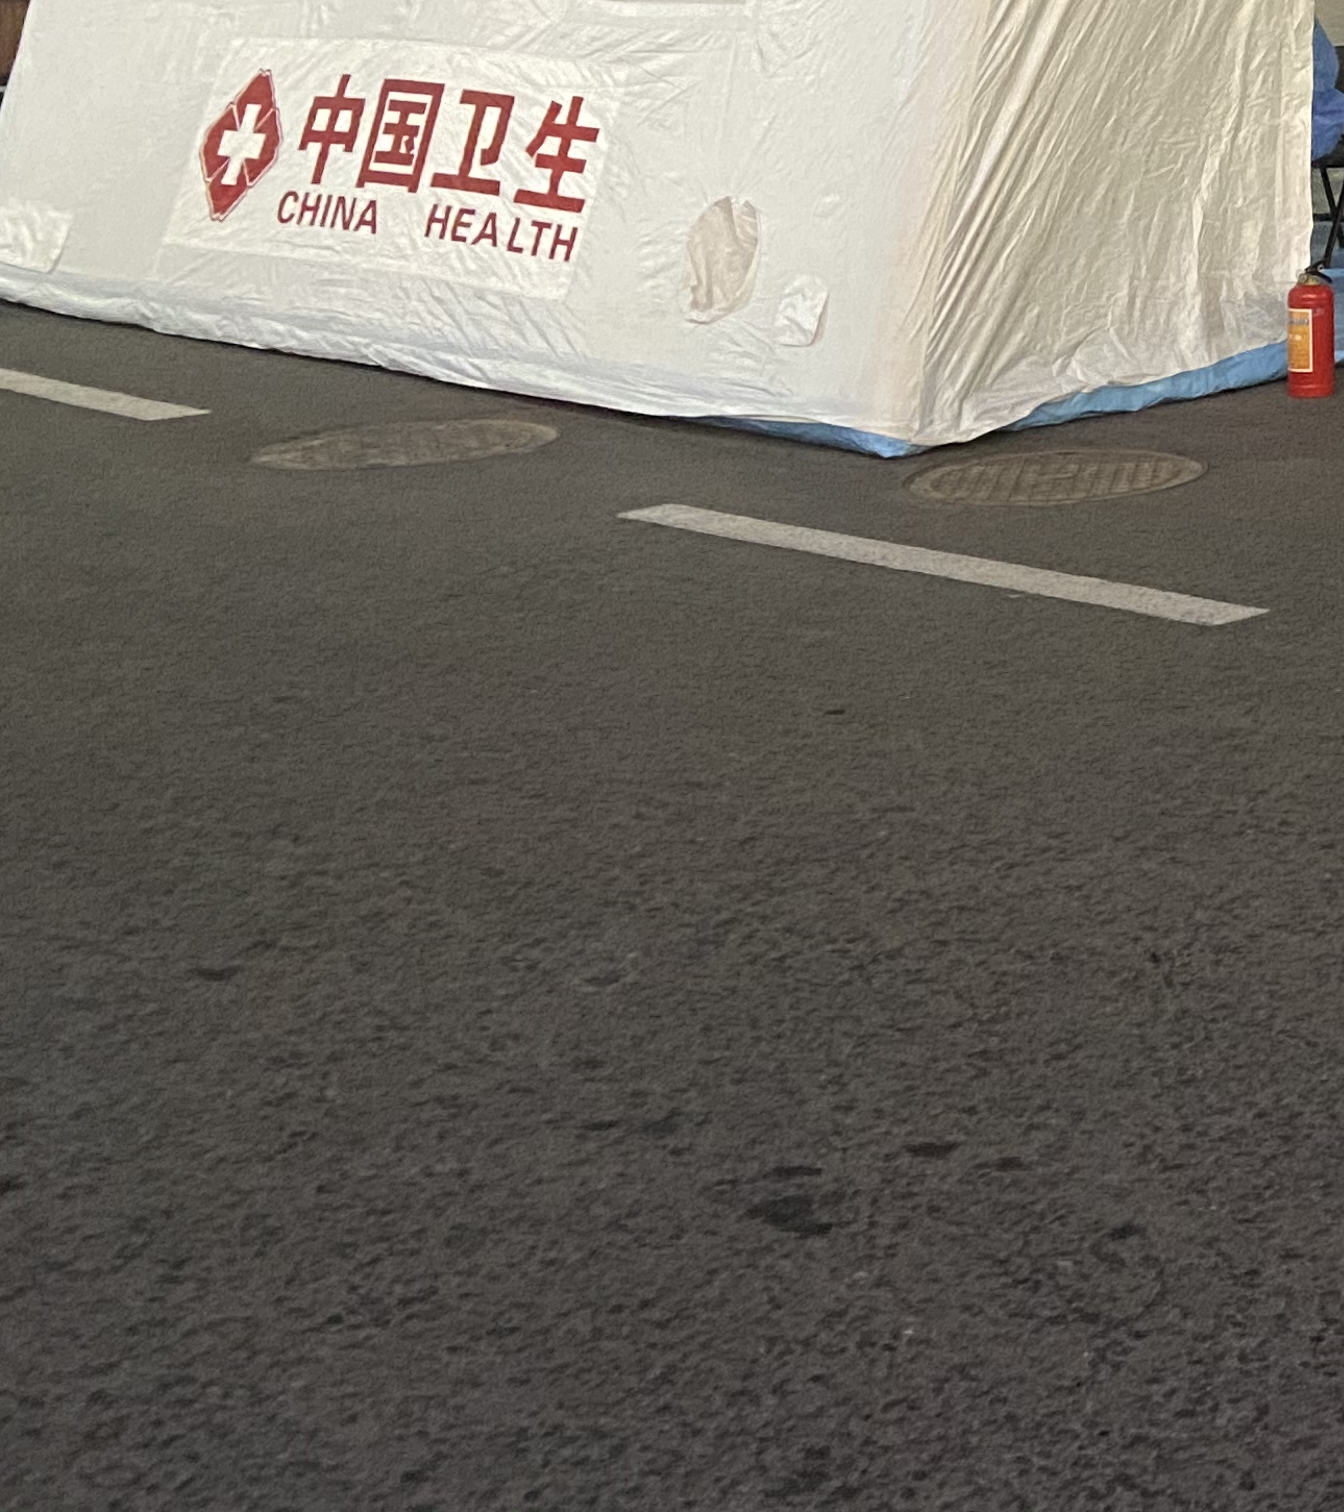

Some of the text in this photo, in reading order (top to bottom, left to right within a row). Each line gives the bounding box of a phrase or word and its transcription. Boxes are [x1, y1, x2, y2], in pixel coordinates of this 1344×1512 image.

[298, 74, 600, 214] 中国卫生
[277, 190, 579, 262] CHINA HEALTH
